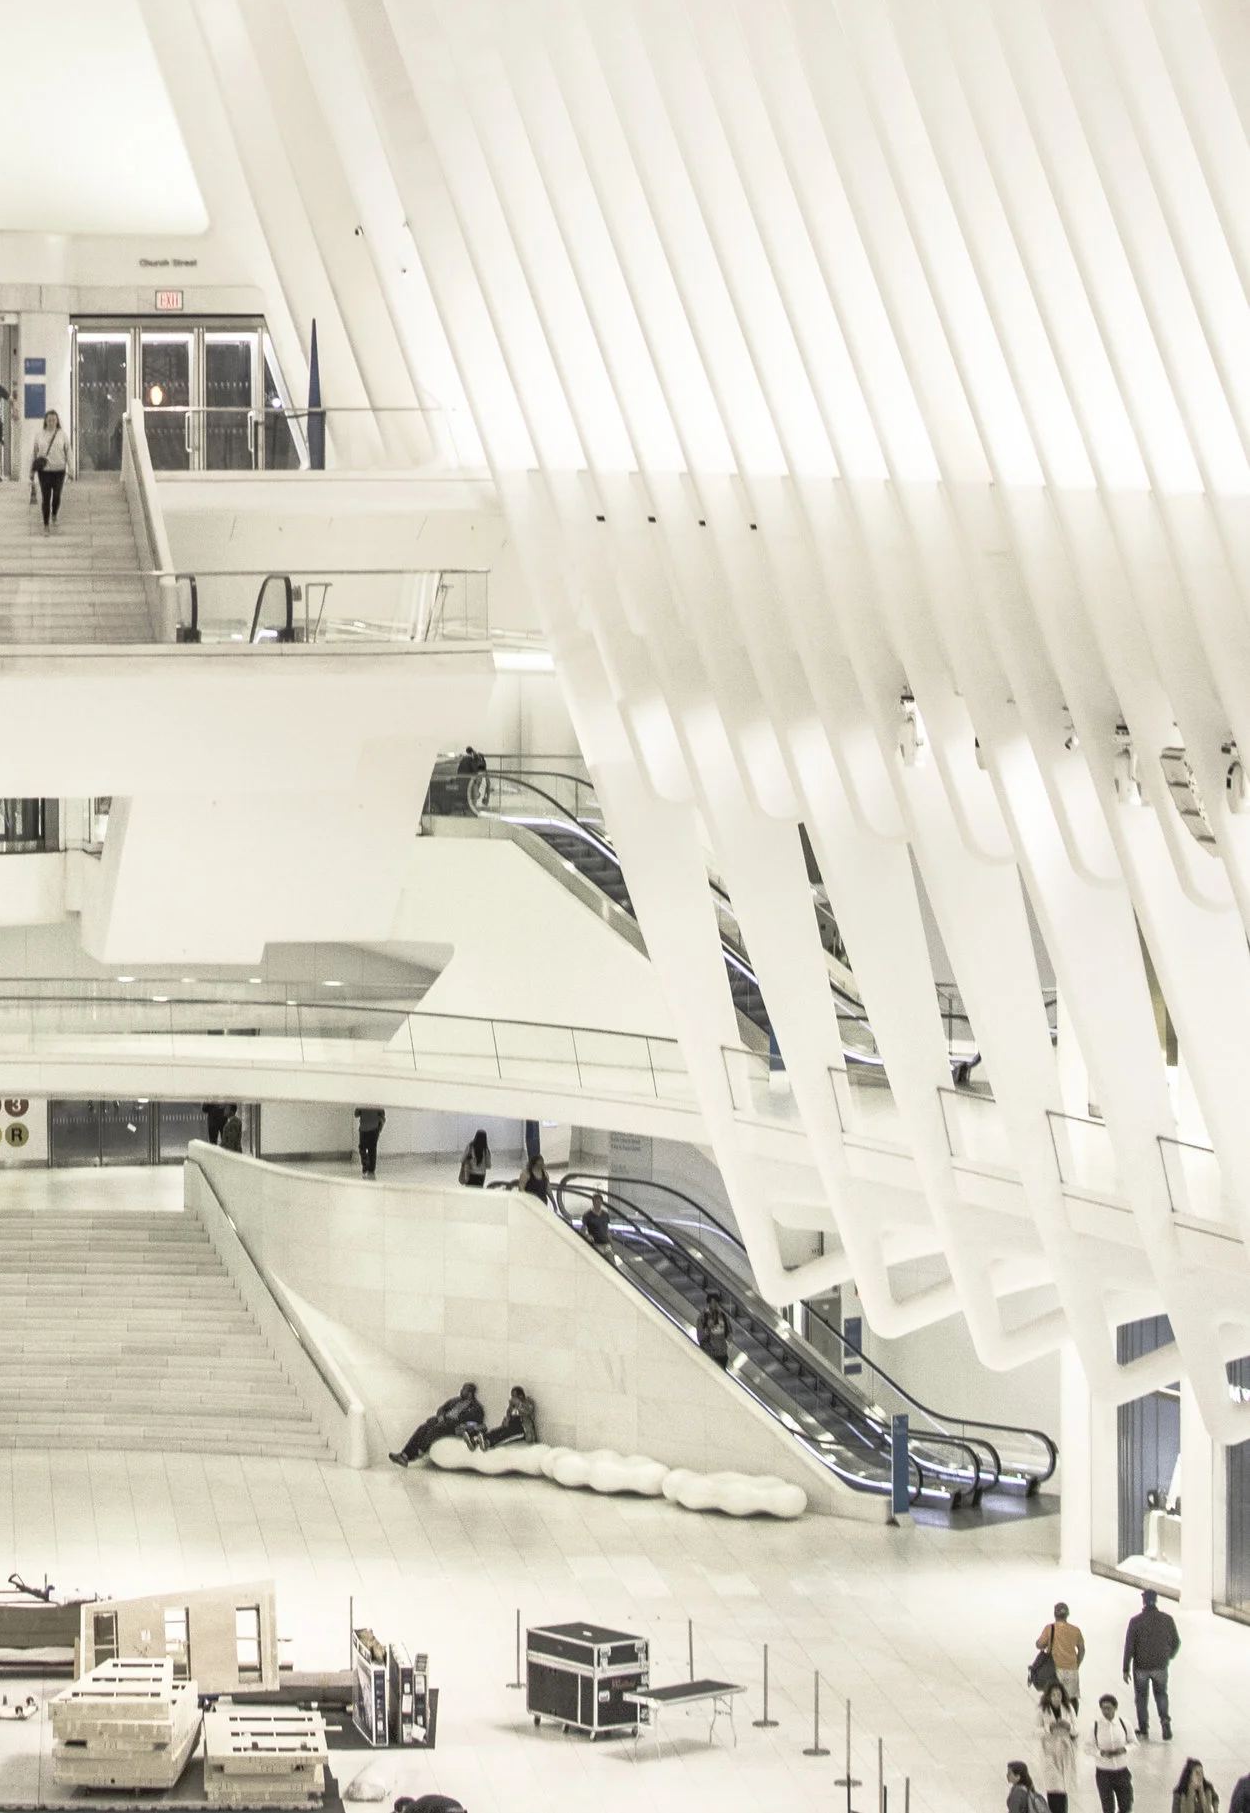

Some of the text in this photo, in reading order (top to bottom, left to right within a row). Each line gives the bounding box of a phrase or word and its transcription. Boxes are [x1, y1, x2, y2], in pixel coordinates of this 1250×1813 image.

[139, 258, 198, 267] Church Street
[159, 292, 179, 309] EXIT
[11, 1128, 23, 1141] R
